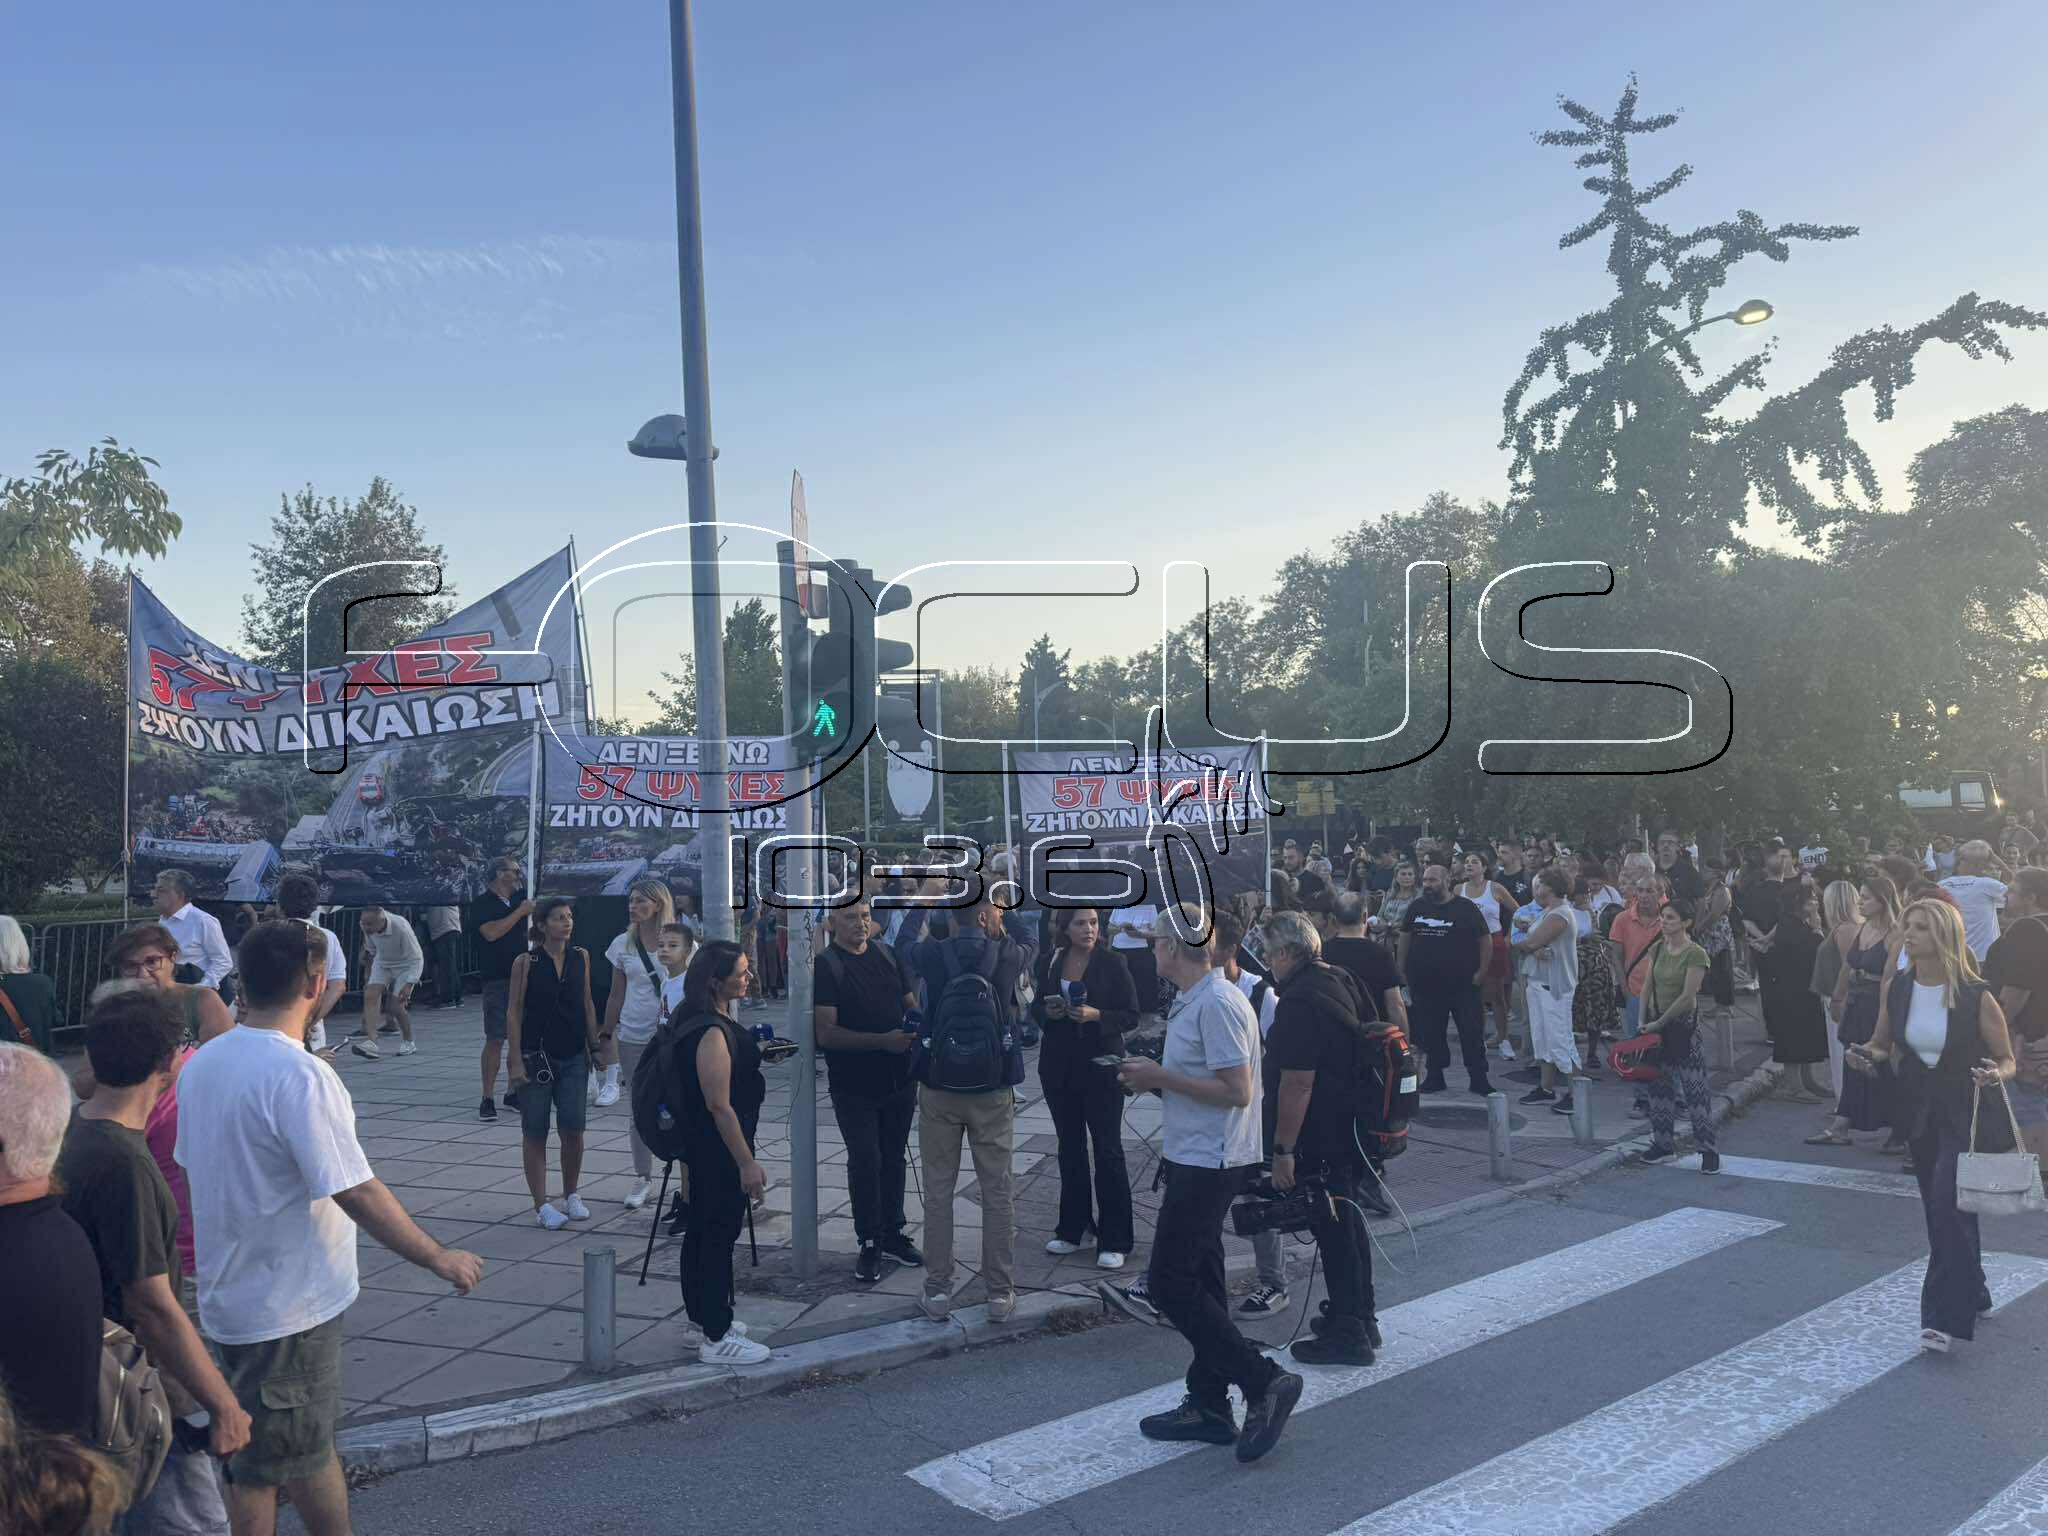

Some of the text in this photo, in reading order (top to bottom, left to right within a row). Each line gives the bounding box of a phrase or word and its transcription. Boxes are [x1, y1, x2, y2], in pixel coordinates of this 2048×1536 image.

[148, 646, 235, 711] 57
[137, 682, 562, 753] ΖΗΤΟΥΝ ΔΙΚΑΙΩΣΗ
[598, 741, 770, 765] ΔΕΝ ΞΕΝΩ
[1069, 754, 1218, 776] ΔΕΝ ΞΕΧΝΩ
[576, 764, 636, 801] 57
[1053, 775, 1243, 808] 57 ΨΥΧΕΣ
[550, 804, 662, 828] ΖΗΤΟΥΝ
[1026, 802, 1266, 833] ΖΗΤΟΥΝ ΔΙΚΑΙΩΣΗ
